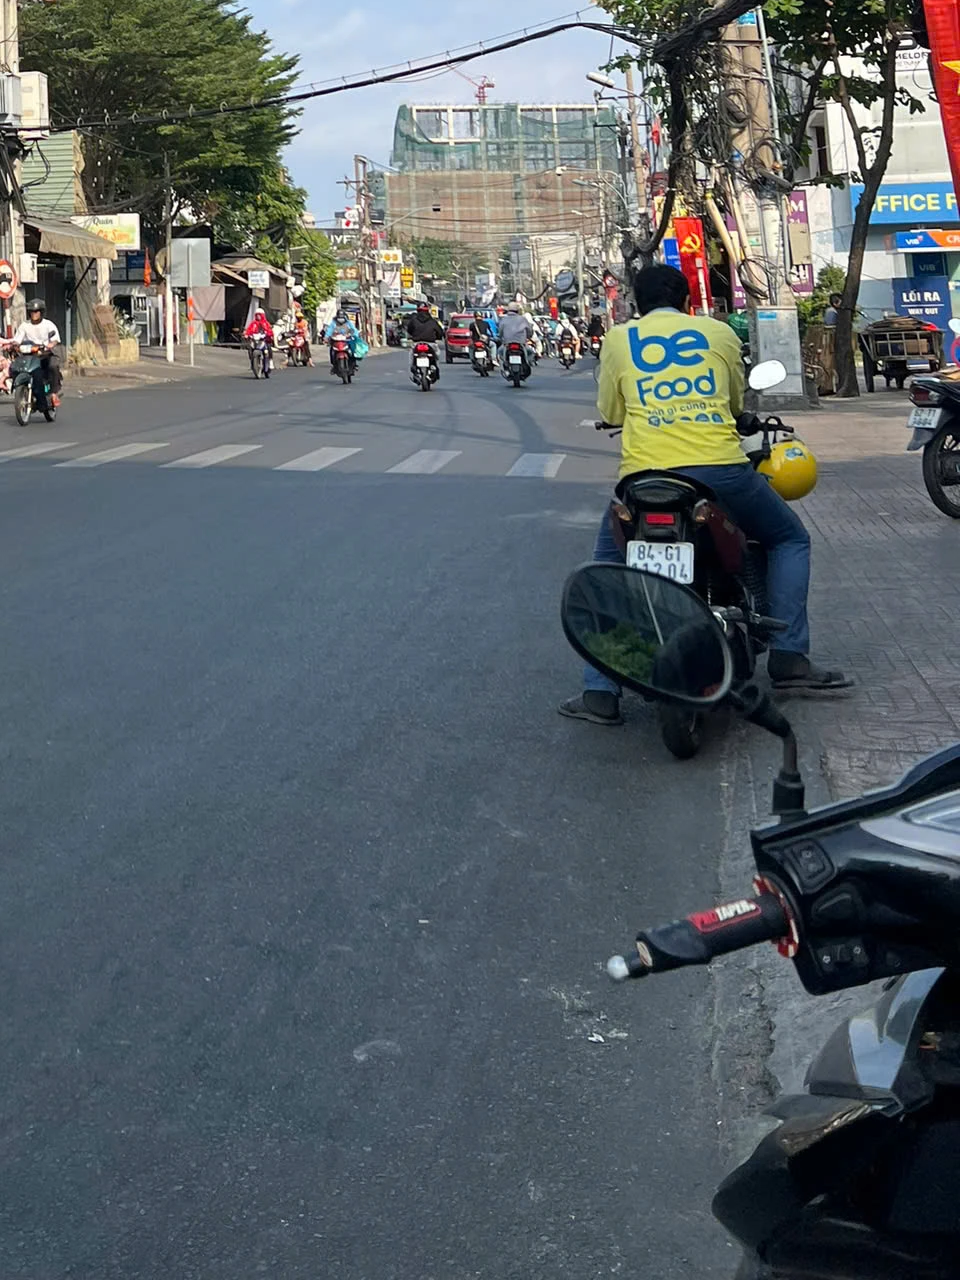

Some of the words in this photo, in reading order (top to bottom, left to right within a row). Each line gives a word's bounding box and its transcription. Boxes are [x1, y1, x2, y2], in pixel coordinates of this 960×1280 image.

[872, 193, 941, 213] FFICE
[924, 291, 941, 302] RA
[628, 326, 710, 373] be
[636, 368, 716, 407] Food
[637, 544, 681, 561] 84-G1
